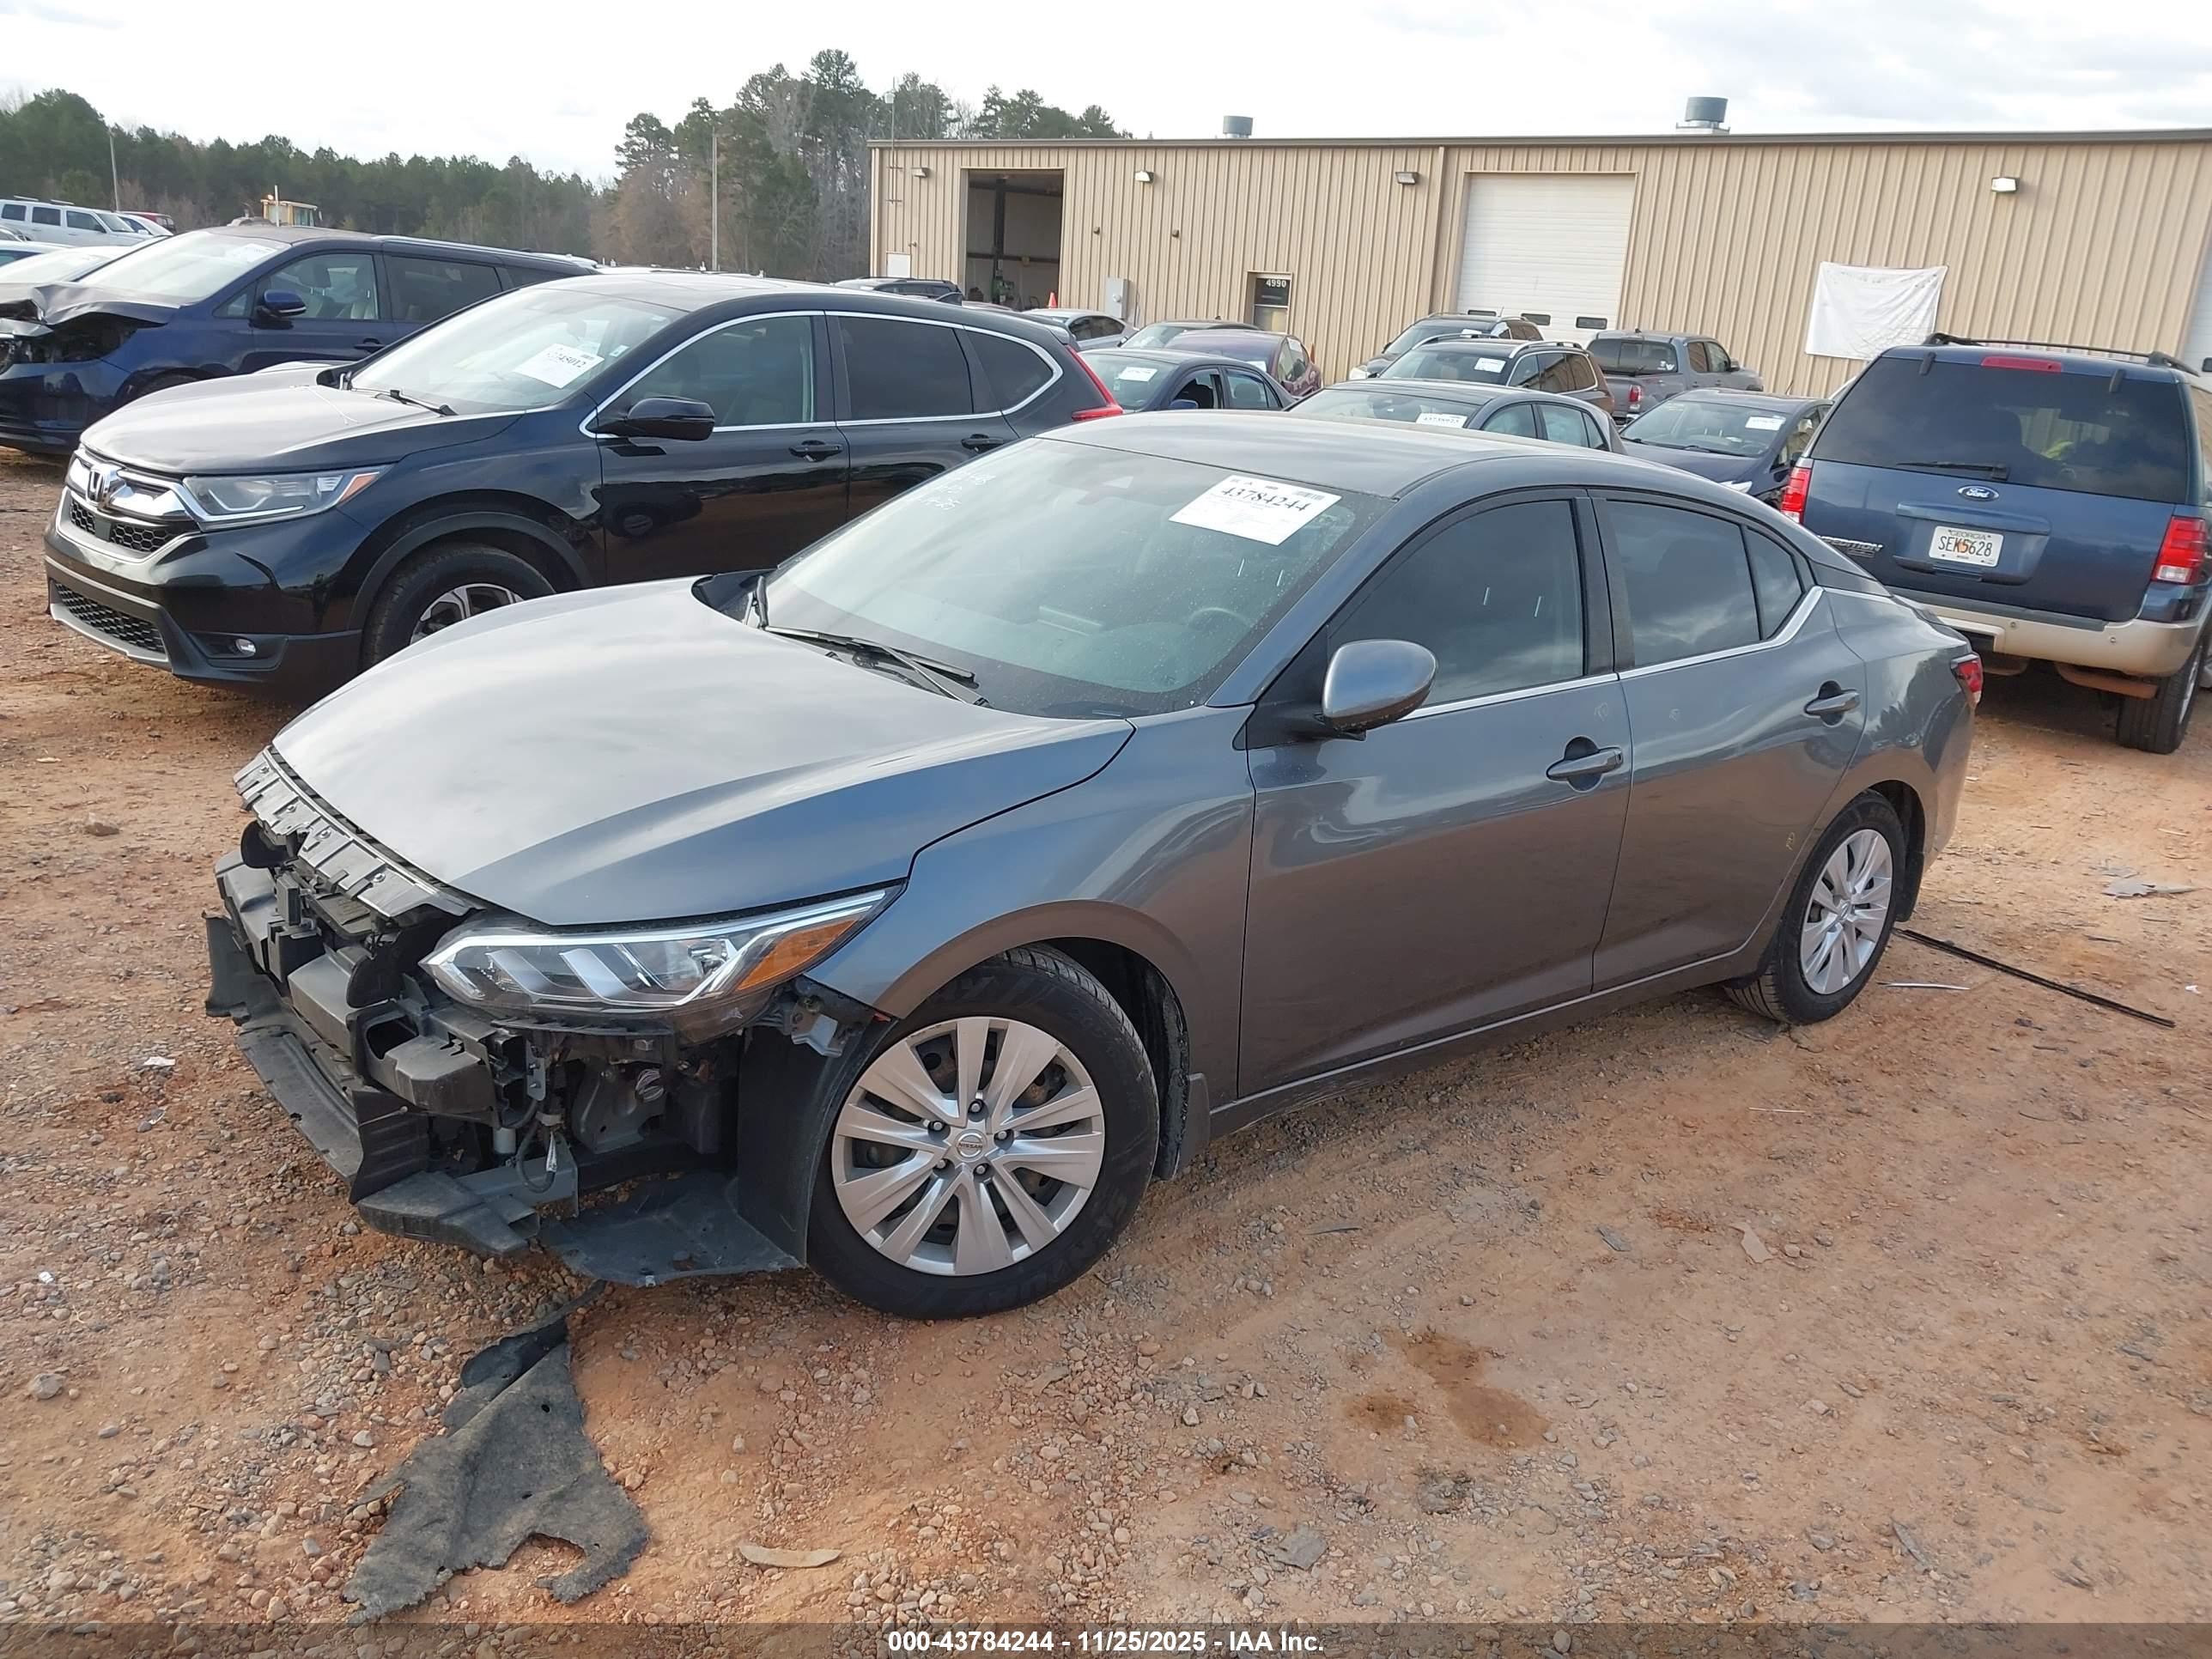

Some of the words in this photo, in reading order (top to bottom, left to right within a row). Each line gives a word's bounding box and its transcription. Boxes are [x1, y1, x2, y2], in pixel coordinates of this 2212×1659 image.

[1266, 279, 1286, 288] 4990
[1220, 487, 1312, 511] 43784244
[1966, 487, 1990, 498] Ford
[1938, 536, 1993, 557] SEK5628
